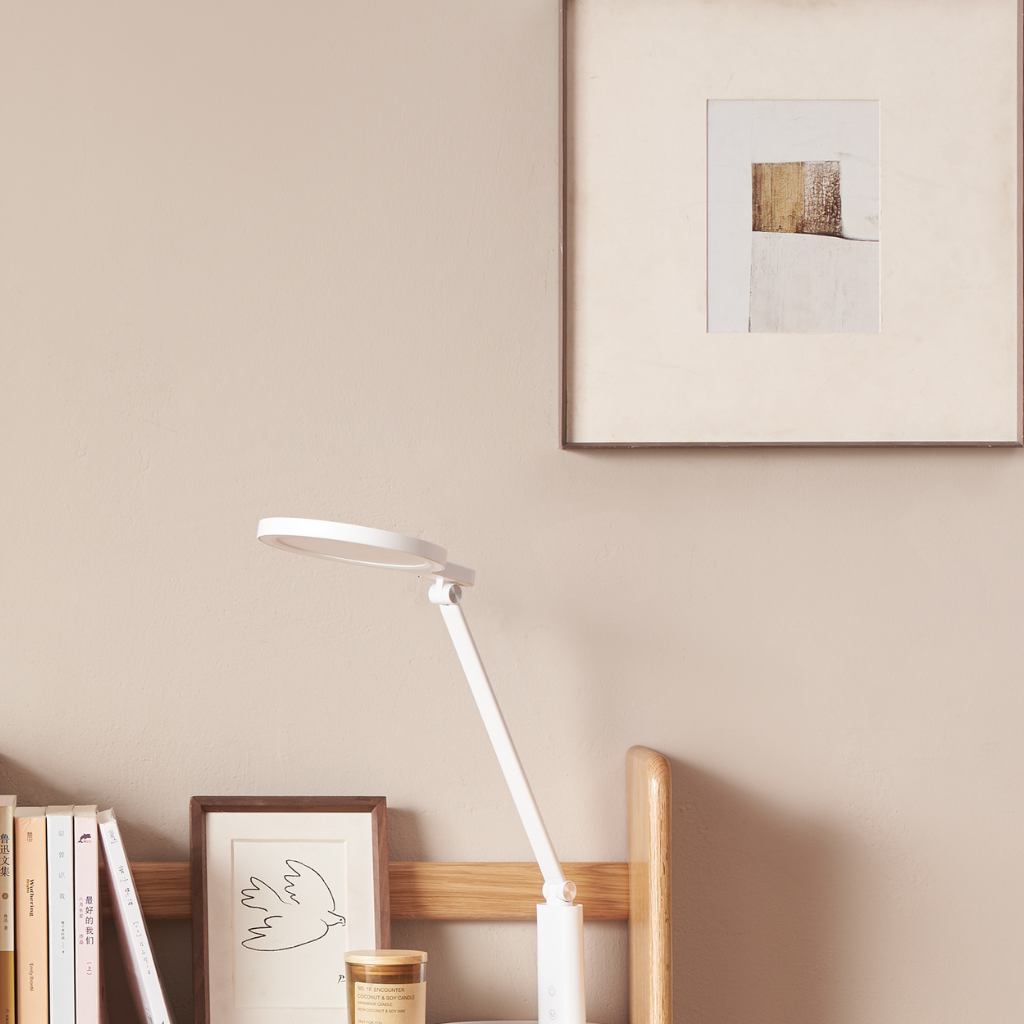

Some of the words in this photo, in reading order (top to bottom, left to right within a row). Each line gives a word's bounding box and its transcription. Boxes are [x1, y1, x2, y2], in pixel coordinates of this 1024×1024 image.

[0, 833, 10, 877] 鲁迅文集
[85, 896, 94, 945] 最好的我们
